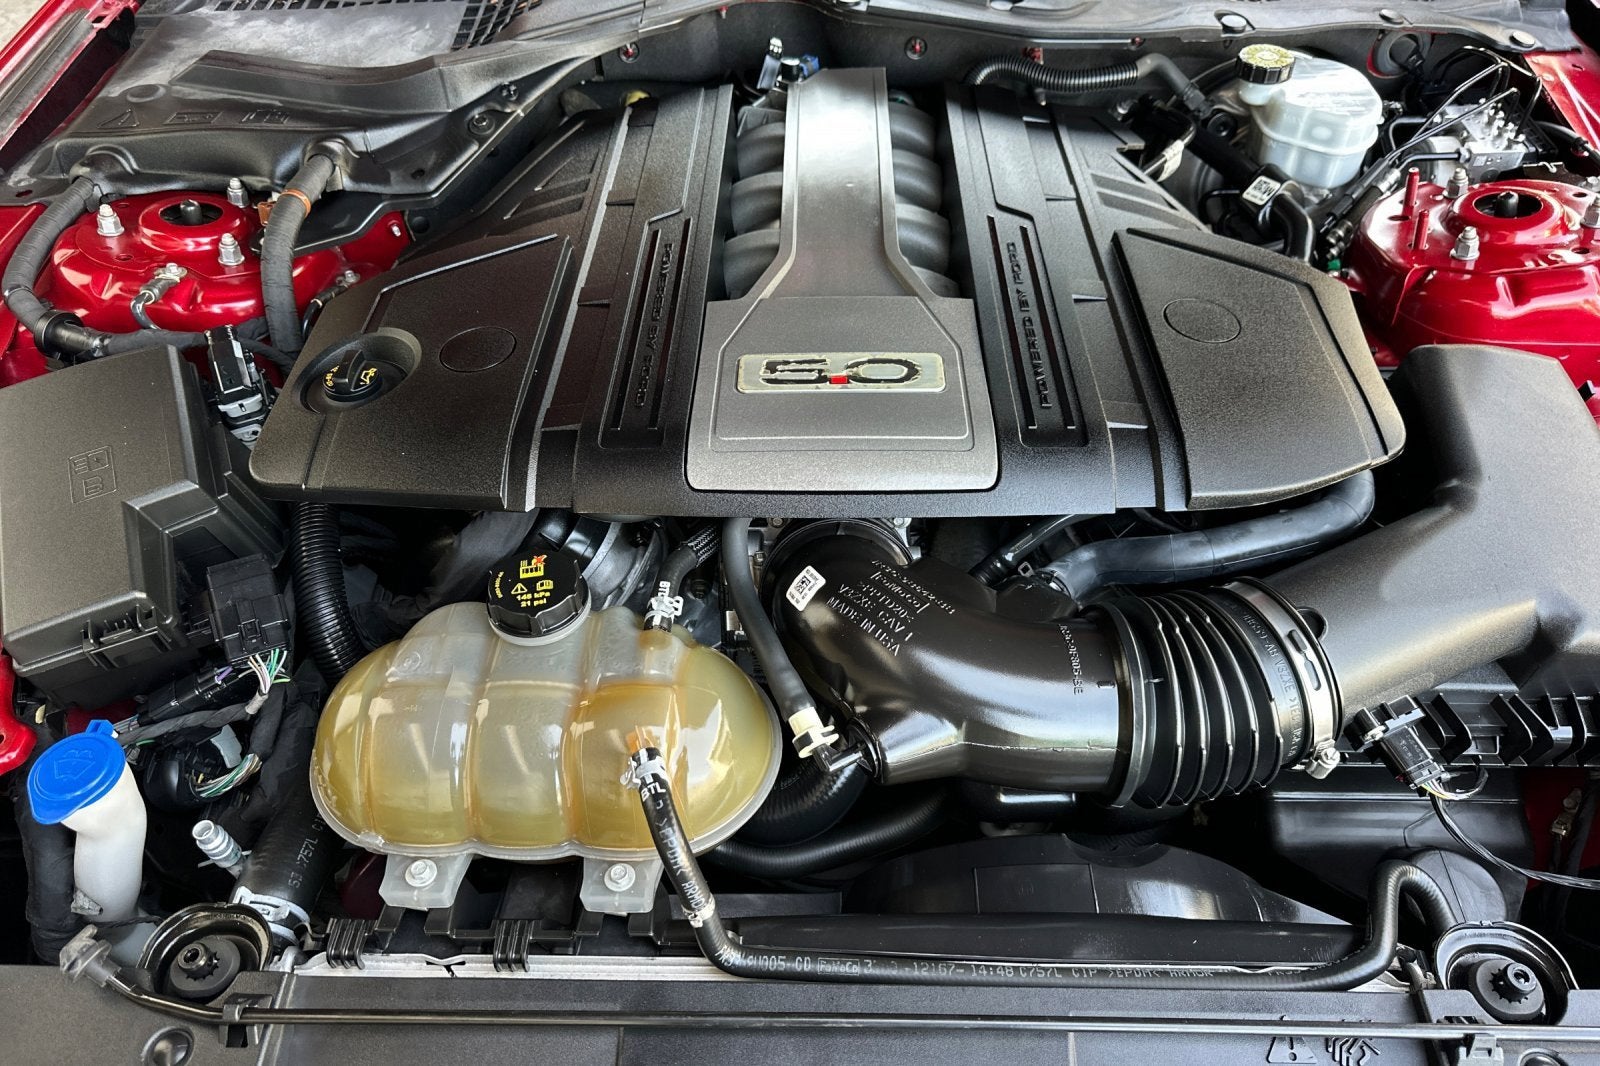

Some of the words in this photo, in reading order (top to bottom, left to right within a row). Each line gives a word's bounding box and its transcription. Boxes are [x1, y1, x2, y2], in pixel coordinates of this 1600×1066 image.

[1006, 241, 1024, 284] FORD
[1017, 288, 1031, 312] BY
[759, 357, 922, 385] 5.0
[1022, 316, 1053, 409] POWERED
[826, 596, 863, 625] MADE
[859, 617, 877, 634] IN
[640, 781, 667, 802] BTL
[682, 880, 706, 911] ARMO
